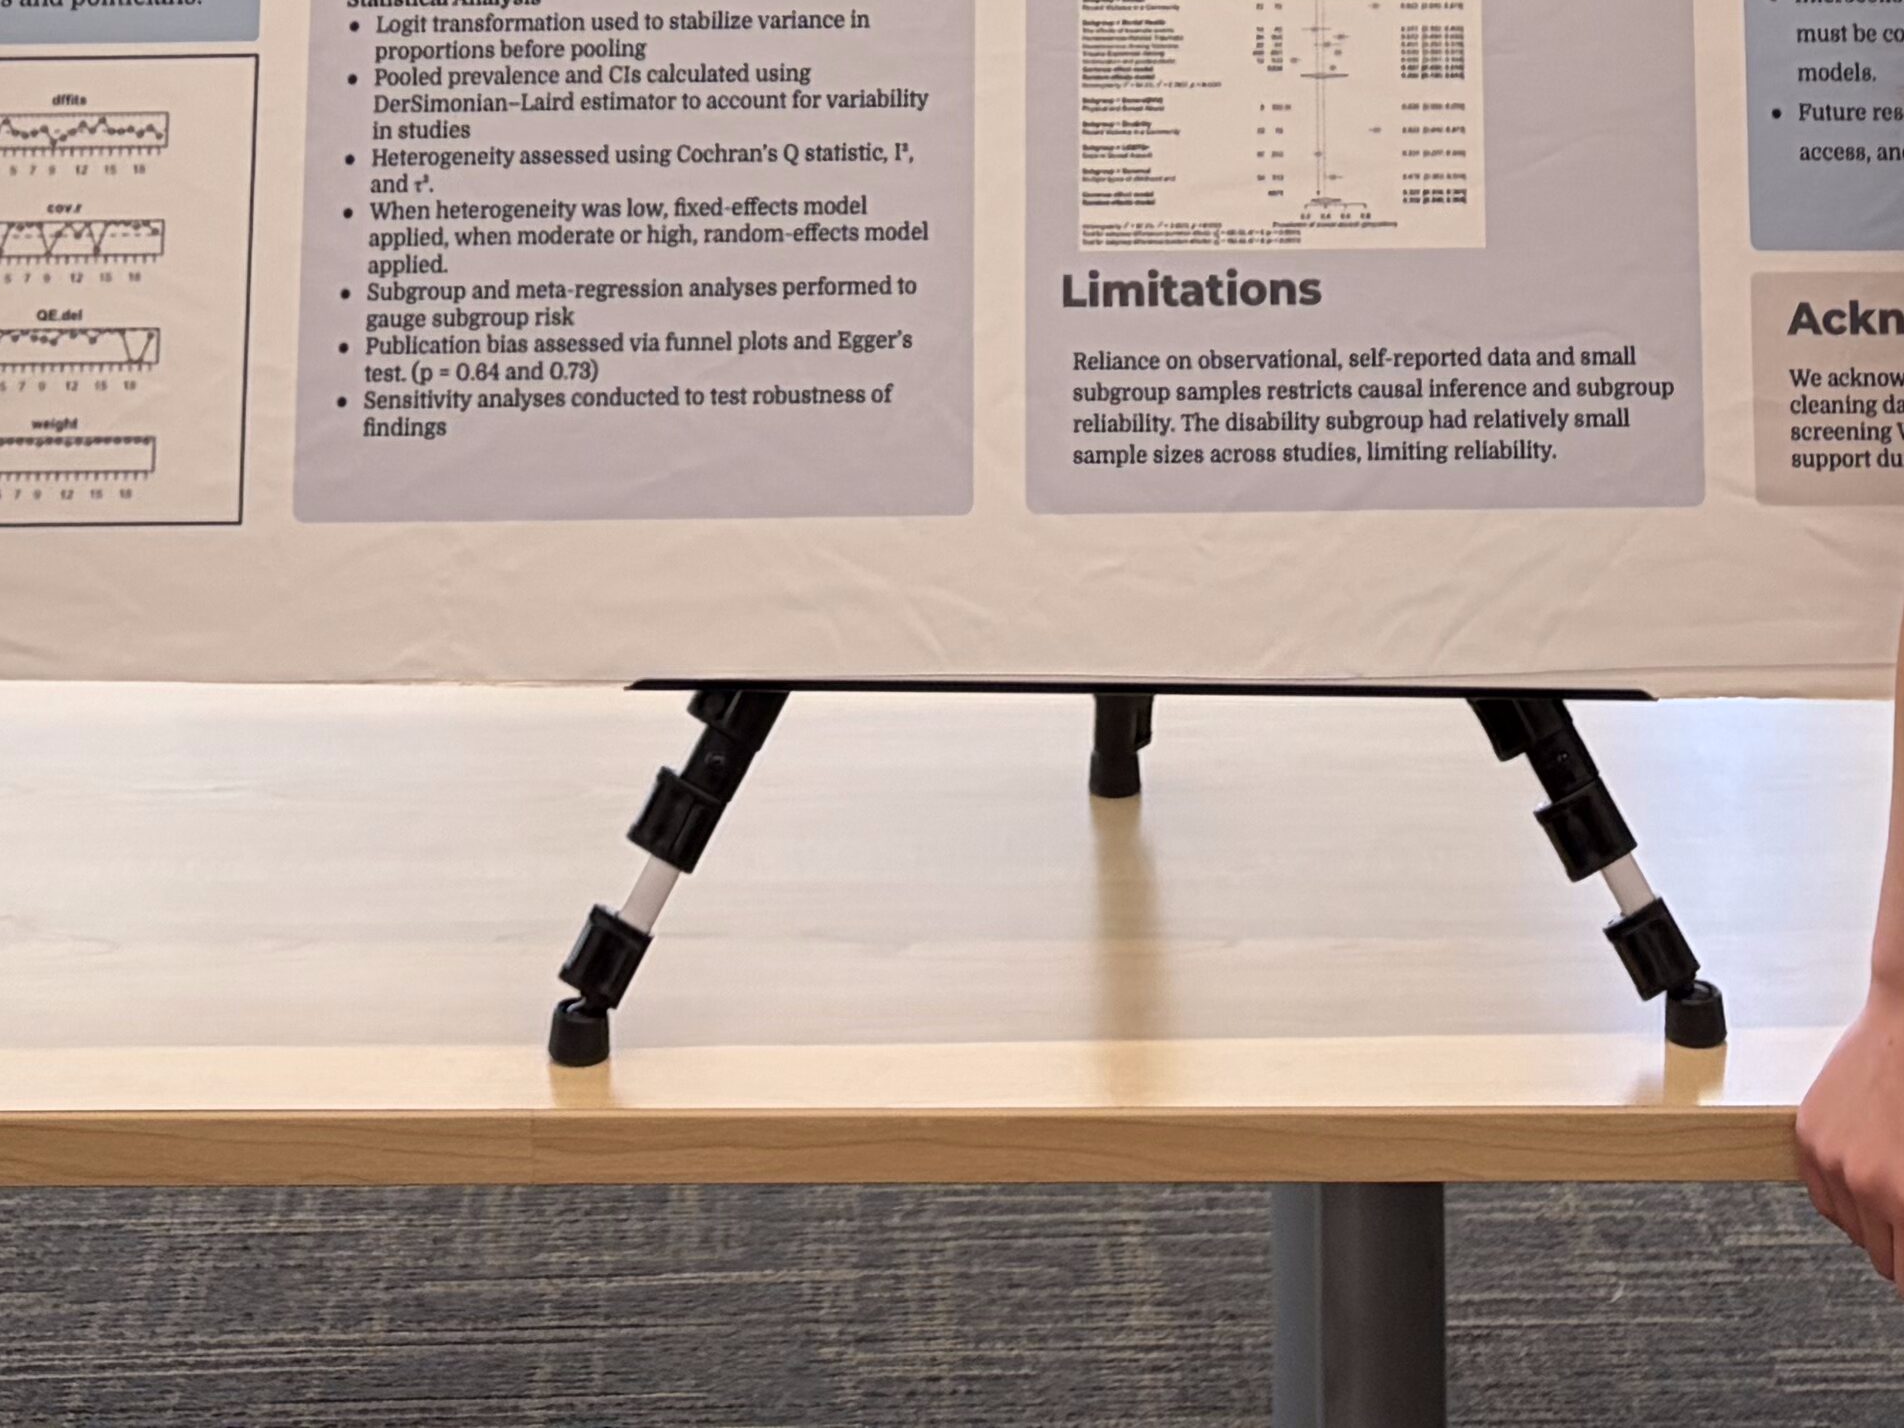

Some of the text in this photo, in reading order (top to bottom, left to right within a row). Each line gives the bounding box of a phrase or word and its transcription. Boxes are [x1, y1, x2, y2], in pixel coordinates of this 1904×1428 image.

[1062, 267, 1323, 309] Limitations
[1072, 344, 1637, 373] Reliance on observational, self-reported data and small
[1788, 367, 1823, 389] We
